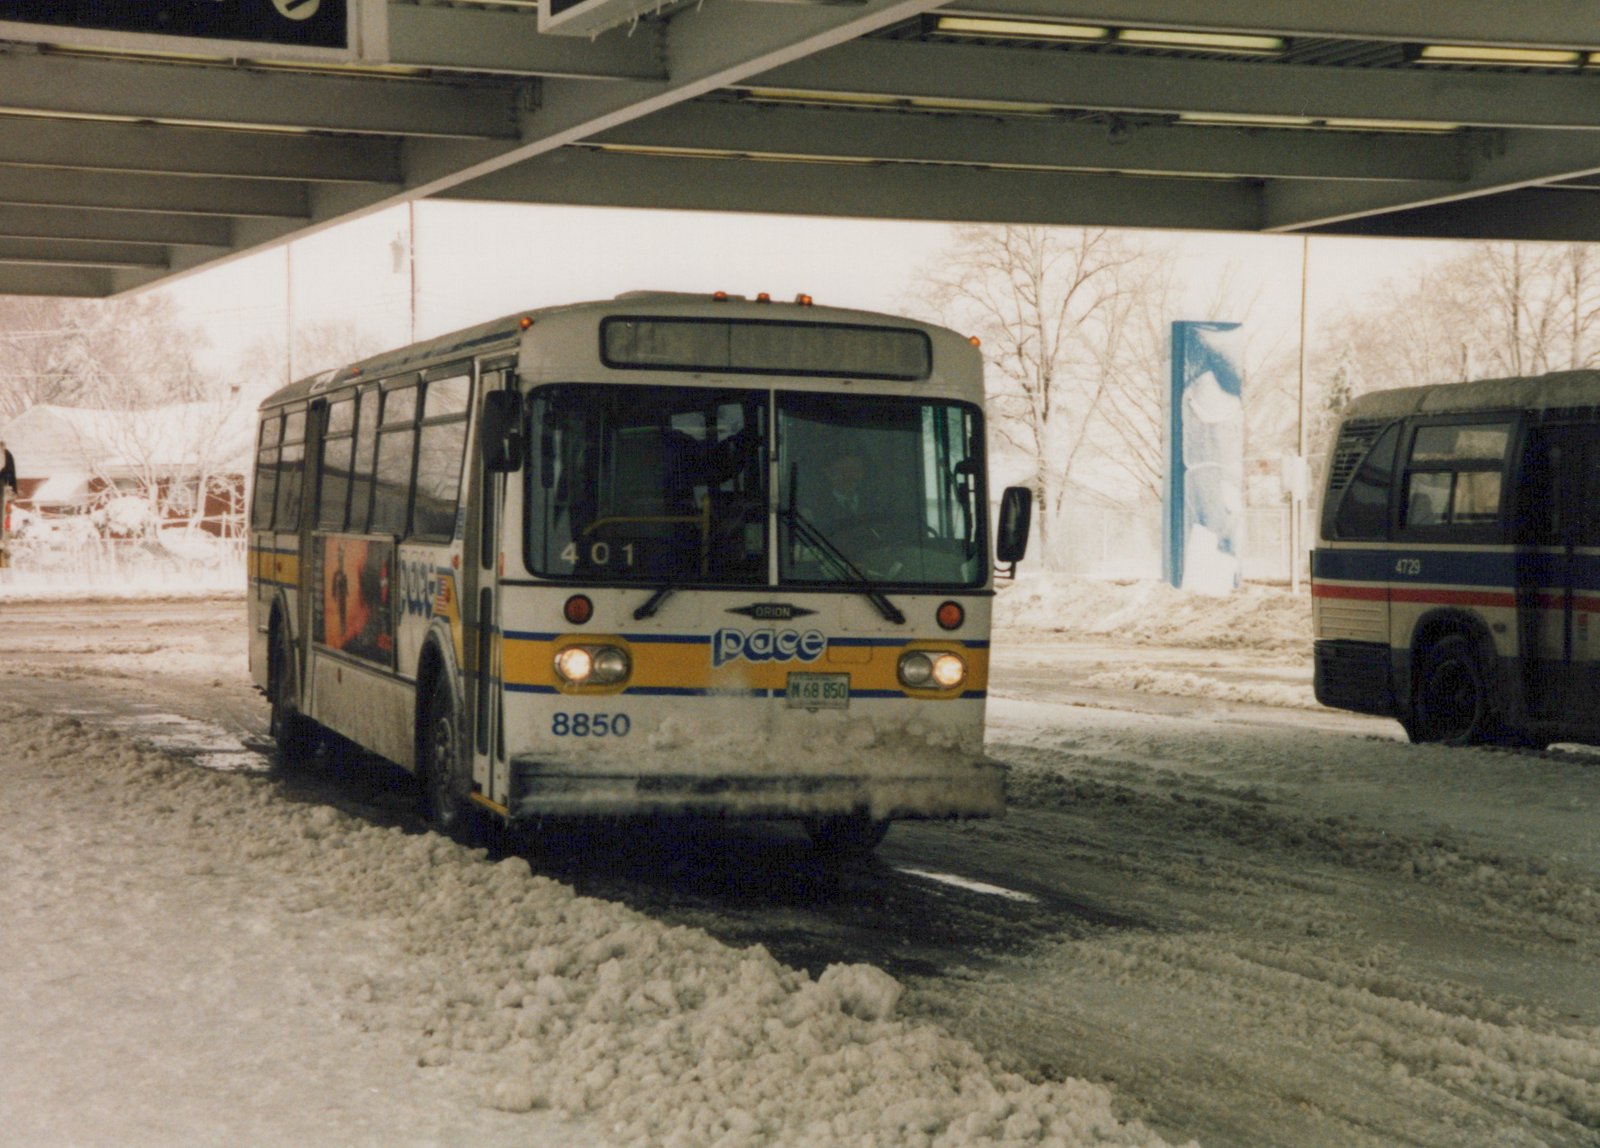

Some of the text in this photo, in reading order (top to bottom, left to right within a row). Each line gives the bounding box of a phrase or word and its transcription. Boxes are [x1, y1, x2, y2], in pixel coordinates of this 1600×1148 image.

[755, 606, 791, 617] ORION
[712, 628, 826, 667] pace
[552, 712, 631, 737] 8850
